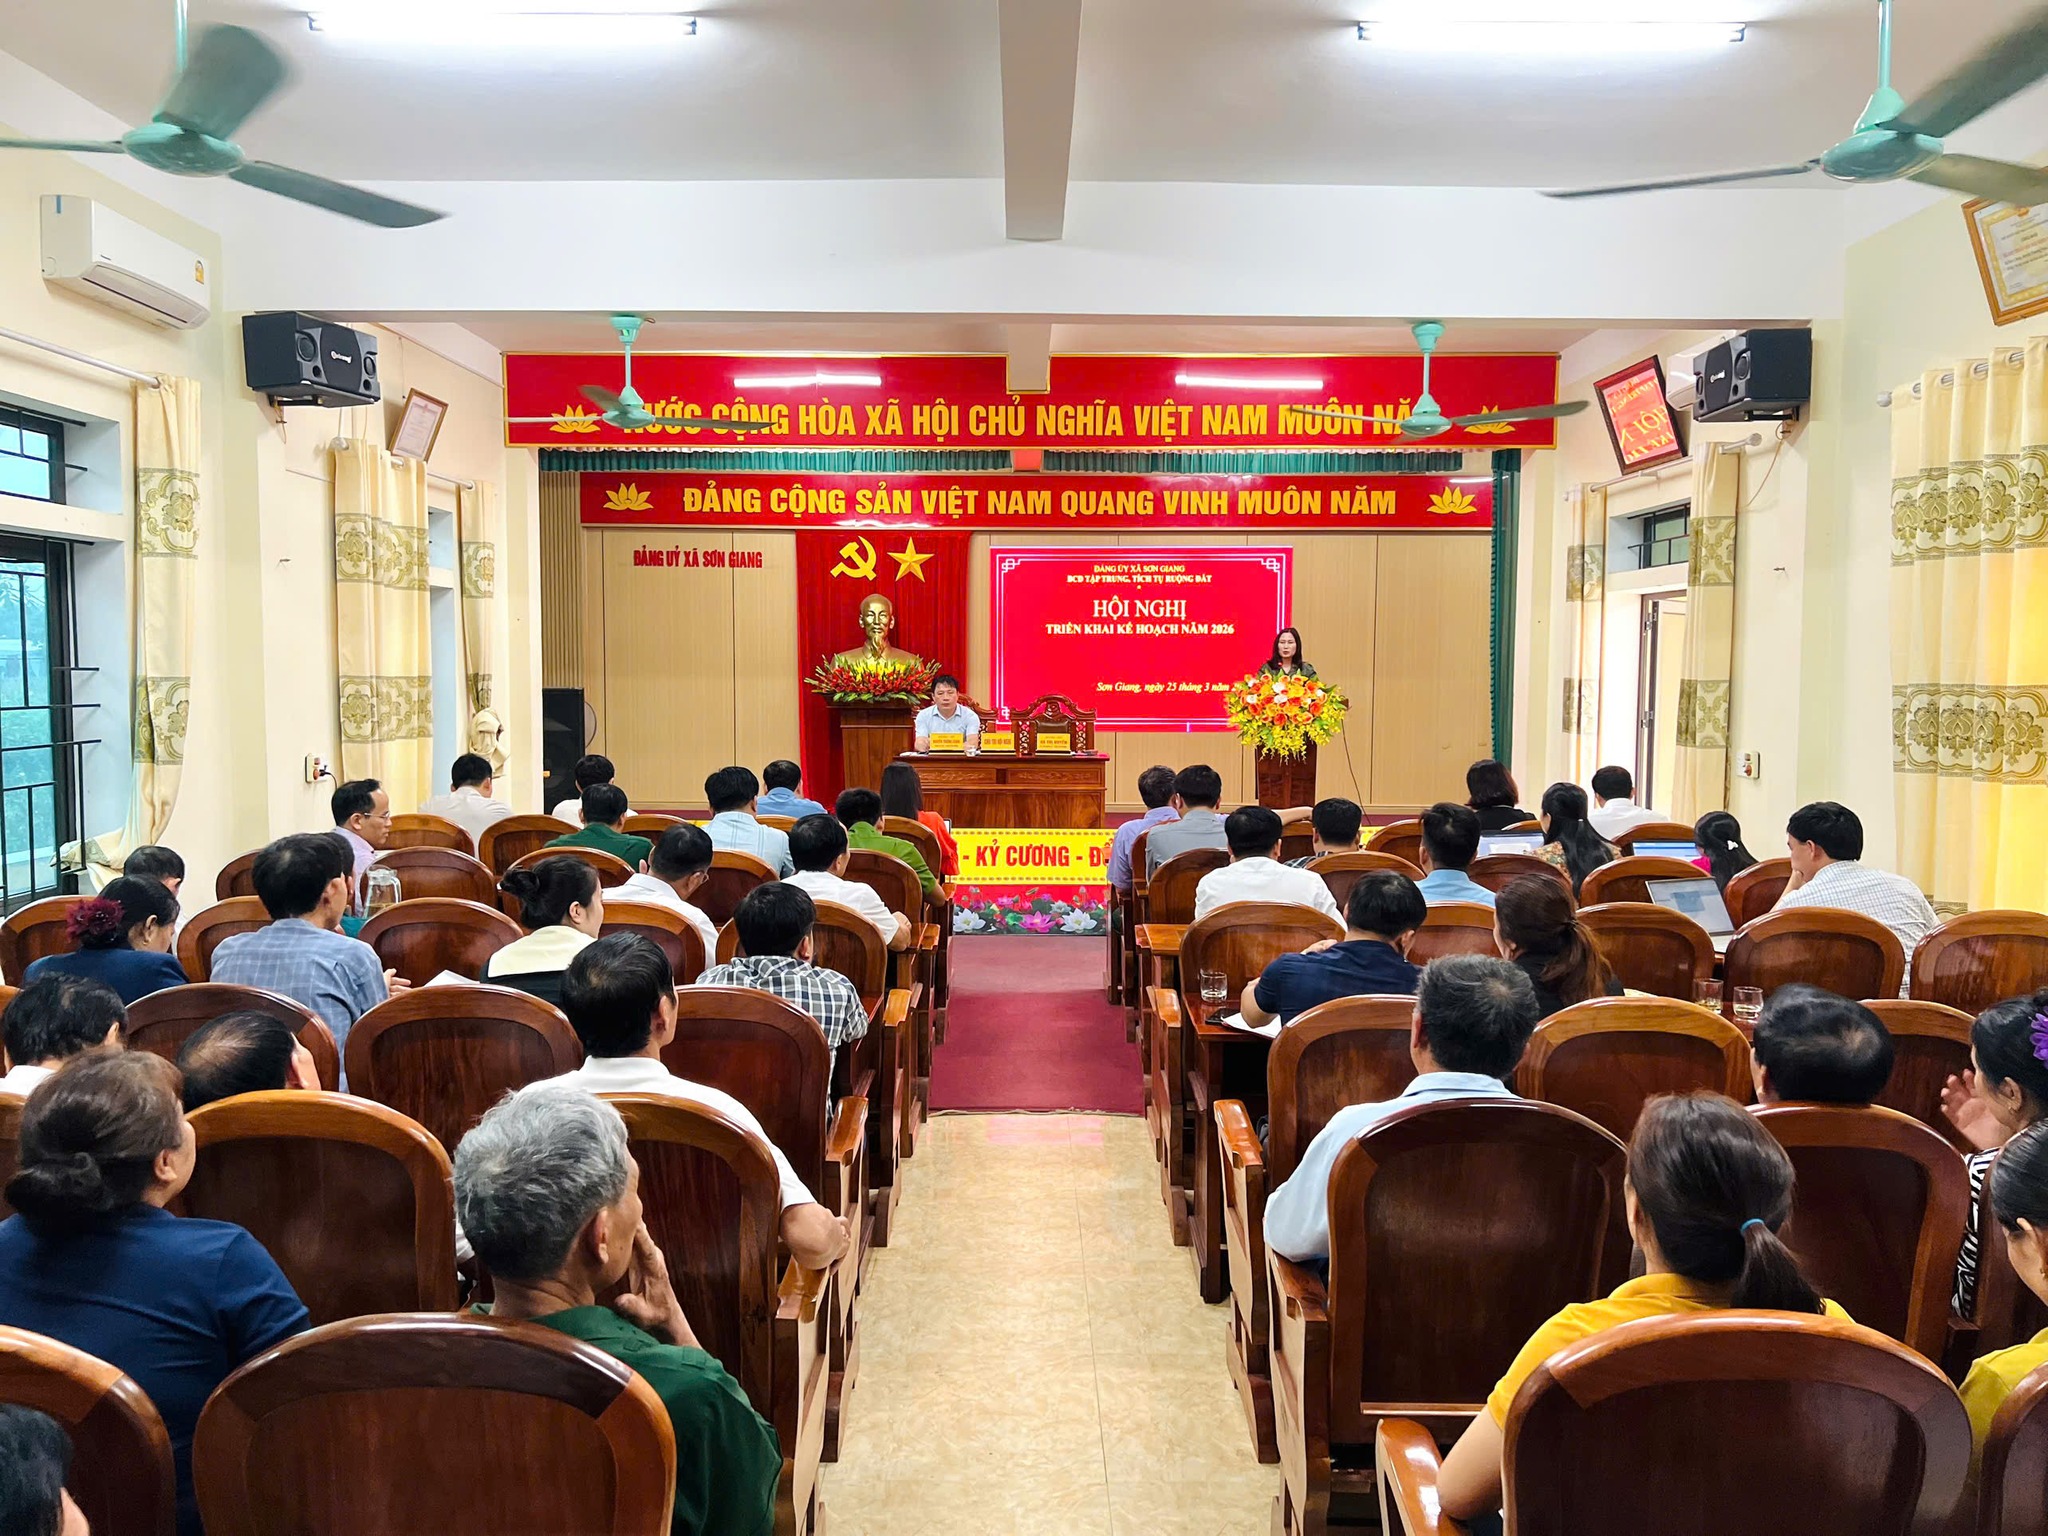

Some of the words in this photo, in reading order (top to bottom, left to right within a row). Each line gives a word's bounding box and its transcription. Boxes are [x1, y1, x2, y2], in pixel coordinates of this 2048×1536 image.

[623, 396, 702, 434] ƯỚC
[711, 396, 790, 441] CỘNG
[798, 396, 857, 435] HÒA
[865, 397, 904, 435] XÃ
[912, 397, 959, 442] HỘI
[970, 390, 1025, 436] CHỦ
[1035, 398, 1124, 436] NGHĨA
[1133, 398, 1194, 443] VIỆT
[1201, 404, 1268, 436] NAM
[1277, 396, 1364, 436] MUÔN
[1372, 396, 1412, 436] NĂ
[683, 480, 762, 513] ĐẢNG
[770, 483, 846, 518] CỘNG
[855, 480, 912, 515] SẢN
[920, 485, 979, 519] VIỆT
[987, 490, 1052, 515] NAM
[1061, 490, 1154, 517] QUANG
[1163, 490, 1229, 515] VINH
[1237, 485, 1322, 515] MUÔN
[1330, 485, 1396, 515] NĂM
[633, 545, 665, 567] ĐẢNG
[683, 548, 700, 568] XÃ
[702, 549, 726, 568] SƠN
[728, 551, 763, 569] GIANG
[1130, 563, 1142, 573] XÃ
[1159, 564, 1186, 573] GIANG
[1093, 594, 1130, 621] HỘI
[1134, 599, 1187, 621] NGHỊ
[1045, 621, 1082, 635] TRIỂN
[1083, 623, 1115, 635] KHAI
[1116, 621, 1134, 635] KẾ
[1135, 623, 1179, 637] HOẠCH
[1181, 621, 1209, 635] NĂM
[1210, 623, 1235, 635] 2026
[1114, 681, 1142, 693] Giang,
[1144, 683, 1165, 694] ngày
[1166, 682, 1178, 692] 25
[1178, 682, 1203, 694] tháng
[1204, 682, 1210, 692] 3
[1211, 683, 1230, 692] năm
[976, 839, 1000, 867] KỶ
[1006, 844, 1070, 867] CƯƠNG
